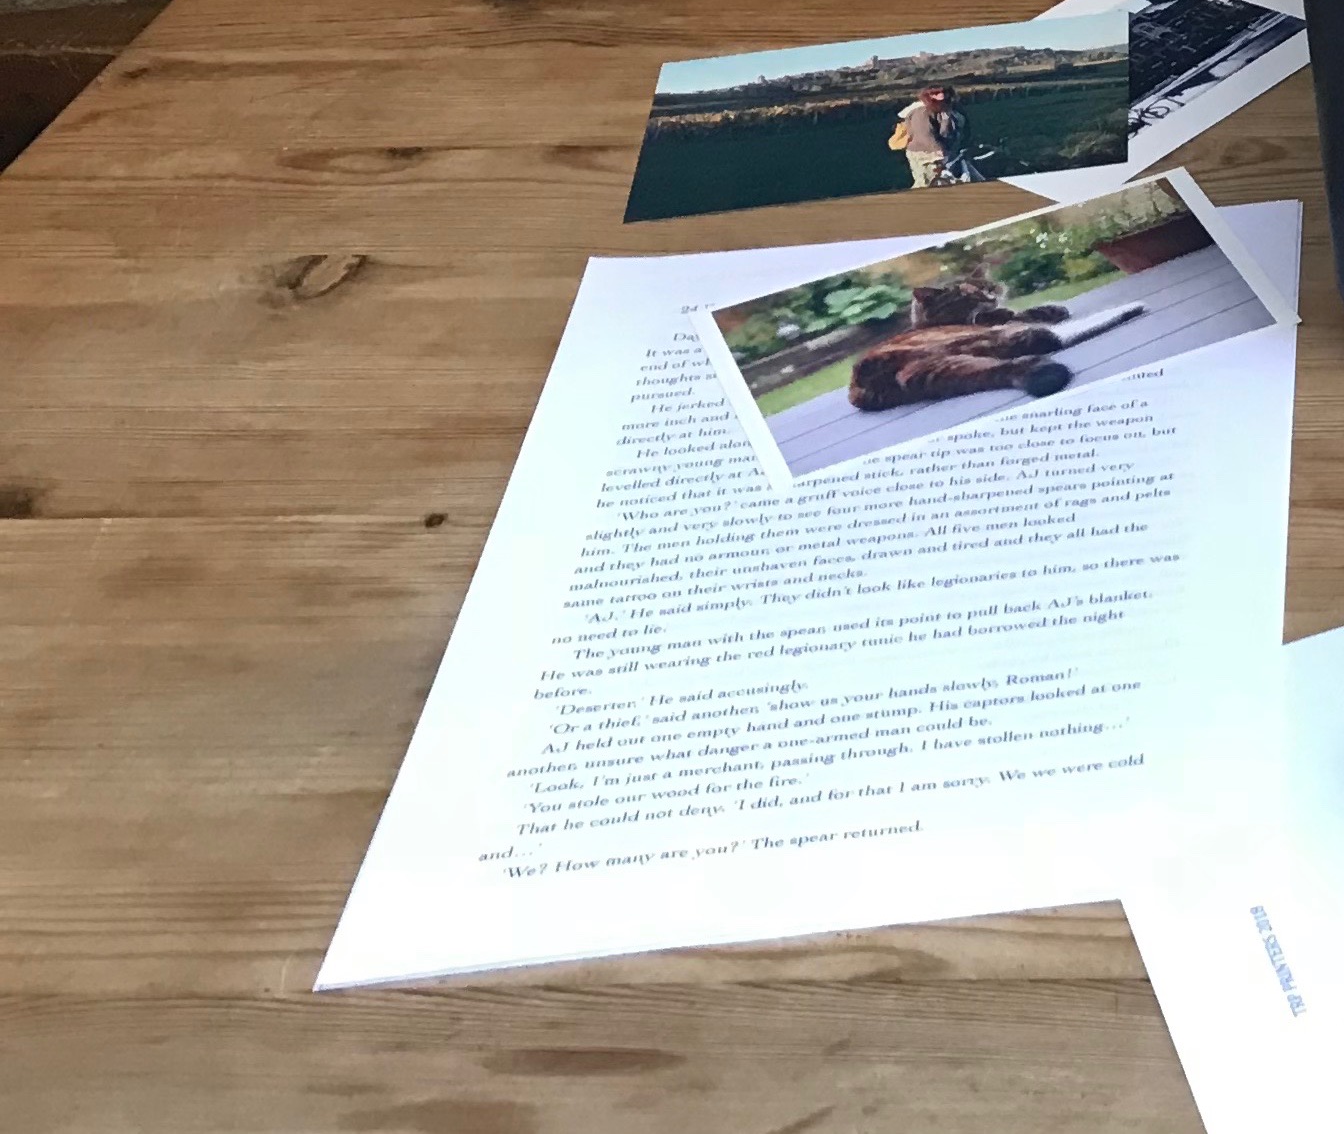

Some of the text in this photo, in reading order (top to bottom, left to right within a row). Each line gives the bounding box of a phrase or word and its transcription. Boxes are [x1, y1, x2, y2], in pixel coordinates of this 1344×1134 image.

[649, 396, 725, 415] He jerked
[1020, 397, 1149, 422] snarling face of a
[614, 430, 677, 446] directly
[676, 429, 694, 440] at
[584, 525, 645, 543] slightly
[646, 520, 680, 536] and
[681, 519, 719, 532] very
[720, 511, 774, 528] slowly
[776, 511, 794, 522] to
[795, 508, 822, 520] see
[825, 504, 858, 517] four
[862, 499, 904, 512] more
[1036, 481, 1088, 496] spears
[1089, 473, 1156, 492] pointing
[1158, 471, 1175, 482] at
[550, 634, 573, 645] no
[576, 626, 619, 643] need
[620, 627, 640, 639] to
[572, 645, 605, 661] The
[605, 642, 663, 661] young
[665, 638, 703, 651] man
[706, 630, 745, 646] with
[747, 627, 775, 642] the
[831, 616, 871, 633] used
[873, 615, 895, 628] its
[896, 611, 943, 629] point
[944, 610, 963, 621] to
[965, 602, 999, 622] pull
[1002, 598, 1042, 615] back
[540, 680, 1142, 755] AJ held out one empty hand and one stump. His captors looked at one
[553, 858, 601, 874] How
[604, 851, 656, 867] many
[658, 848, 689, 860] are
[749, 834, 785, 851] The
[788, 831, 839, 849] spear
[1247, 903, 1308, 1018] TRP PRINTERS 2018
